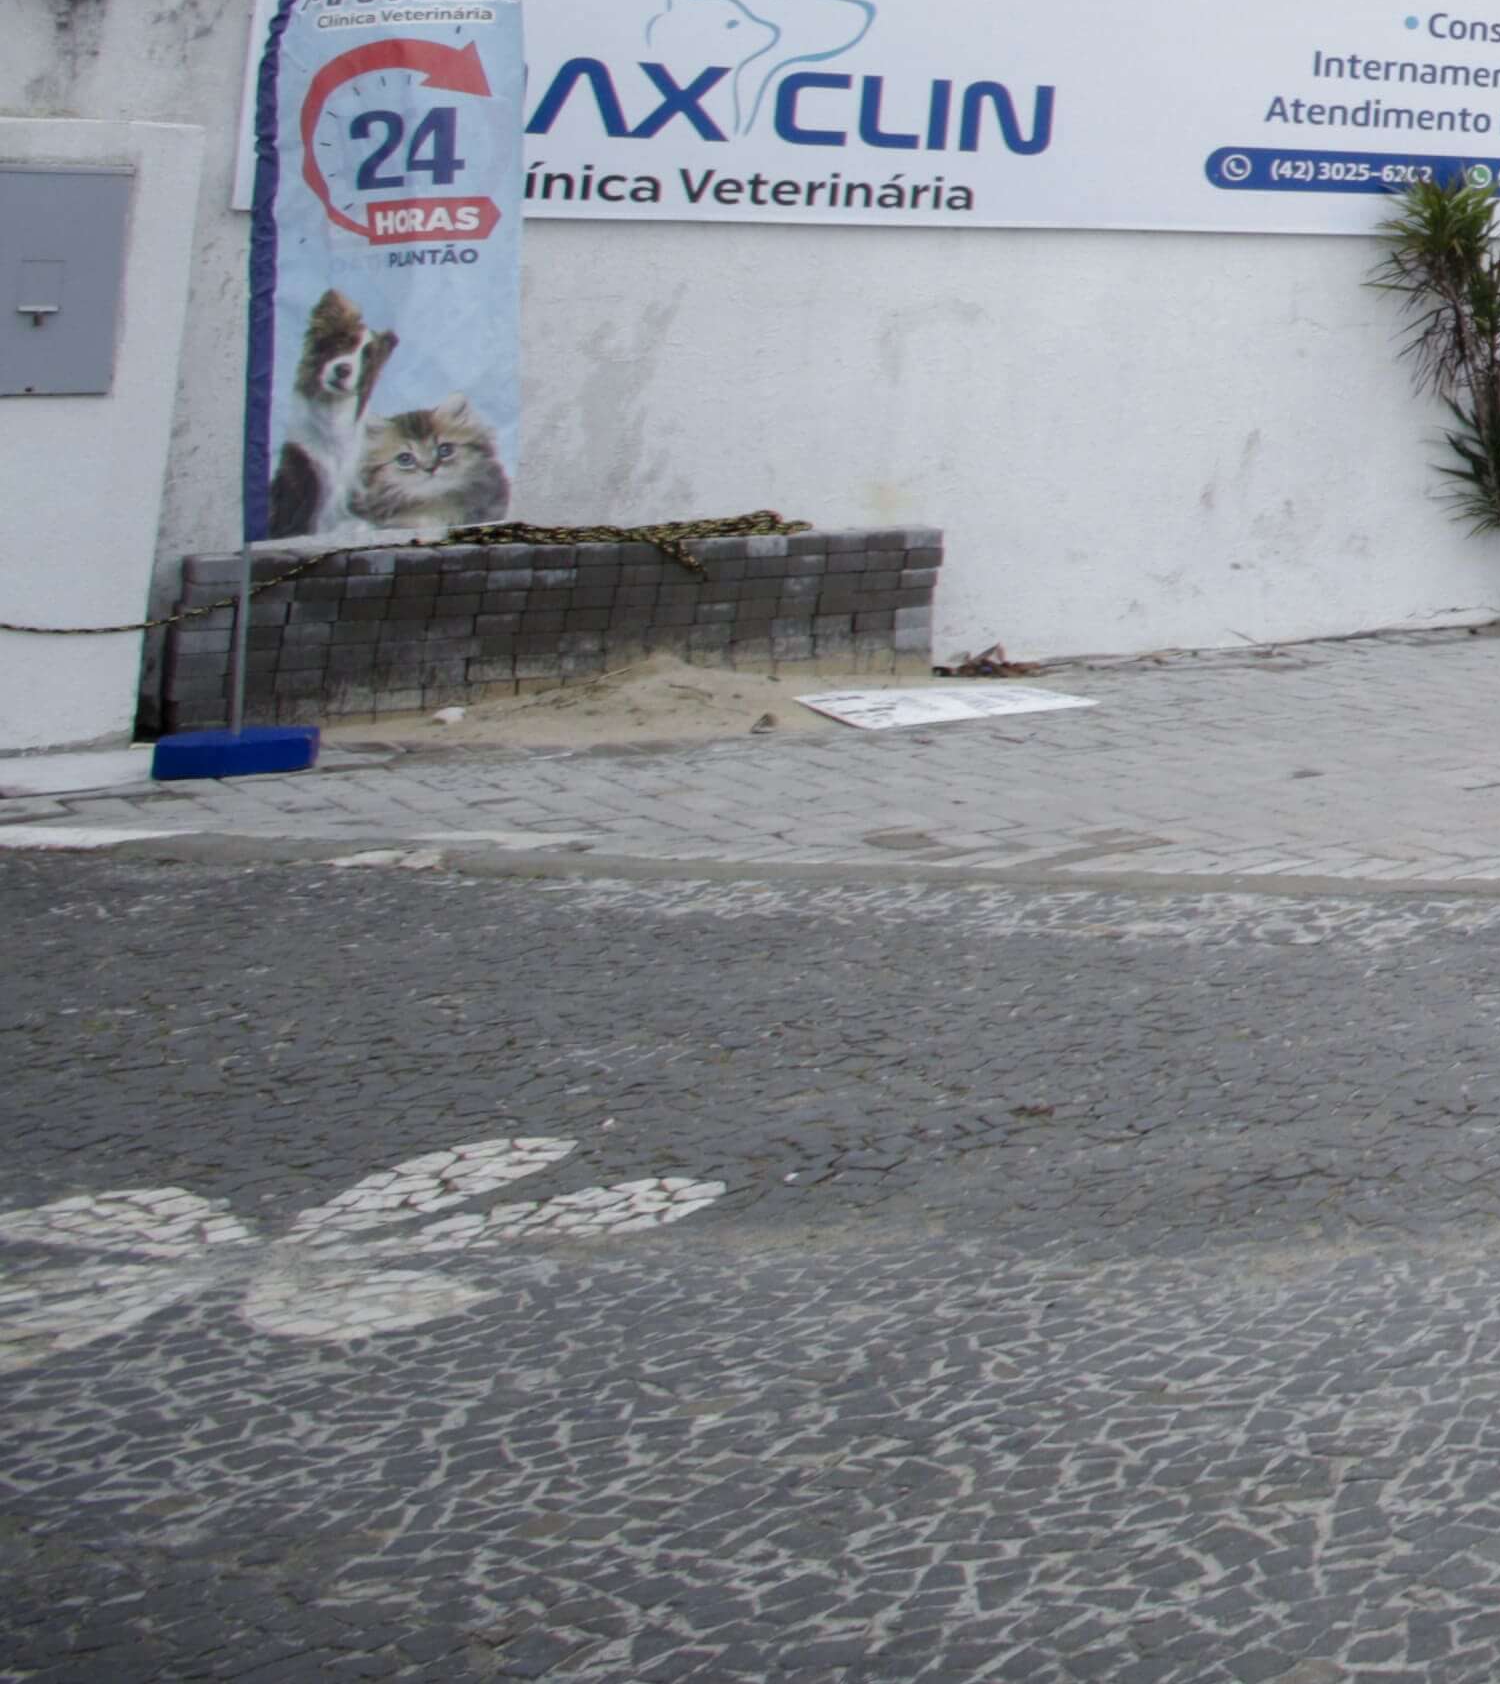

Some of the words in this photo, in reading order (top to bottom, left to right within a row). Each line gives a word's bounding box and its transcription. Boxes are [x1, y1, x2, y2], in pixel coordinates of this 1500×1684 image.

[381, 6, 493, 22] Veterinária
[525, 57, 732, 142] AX
[774, 70, 1056, 156] CLIN
[1264, 96, 1491, 133] Atendimento
[350, 107, 466, 190] 24
[525, 161, 661, 204] ínica
[679, 167, 974, 211] Veterinária
[1270, 159, 1315, 182] (42)
[375, 206, 481, 237] HORAS
